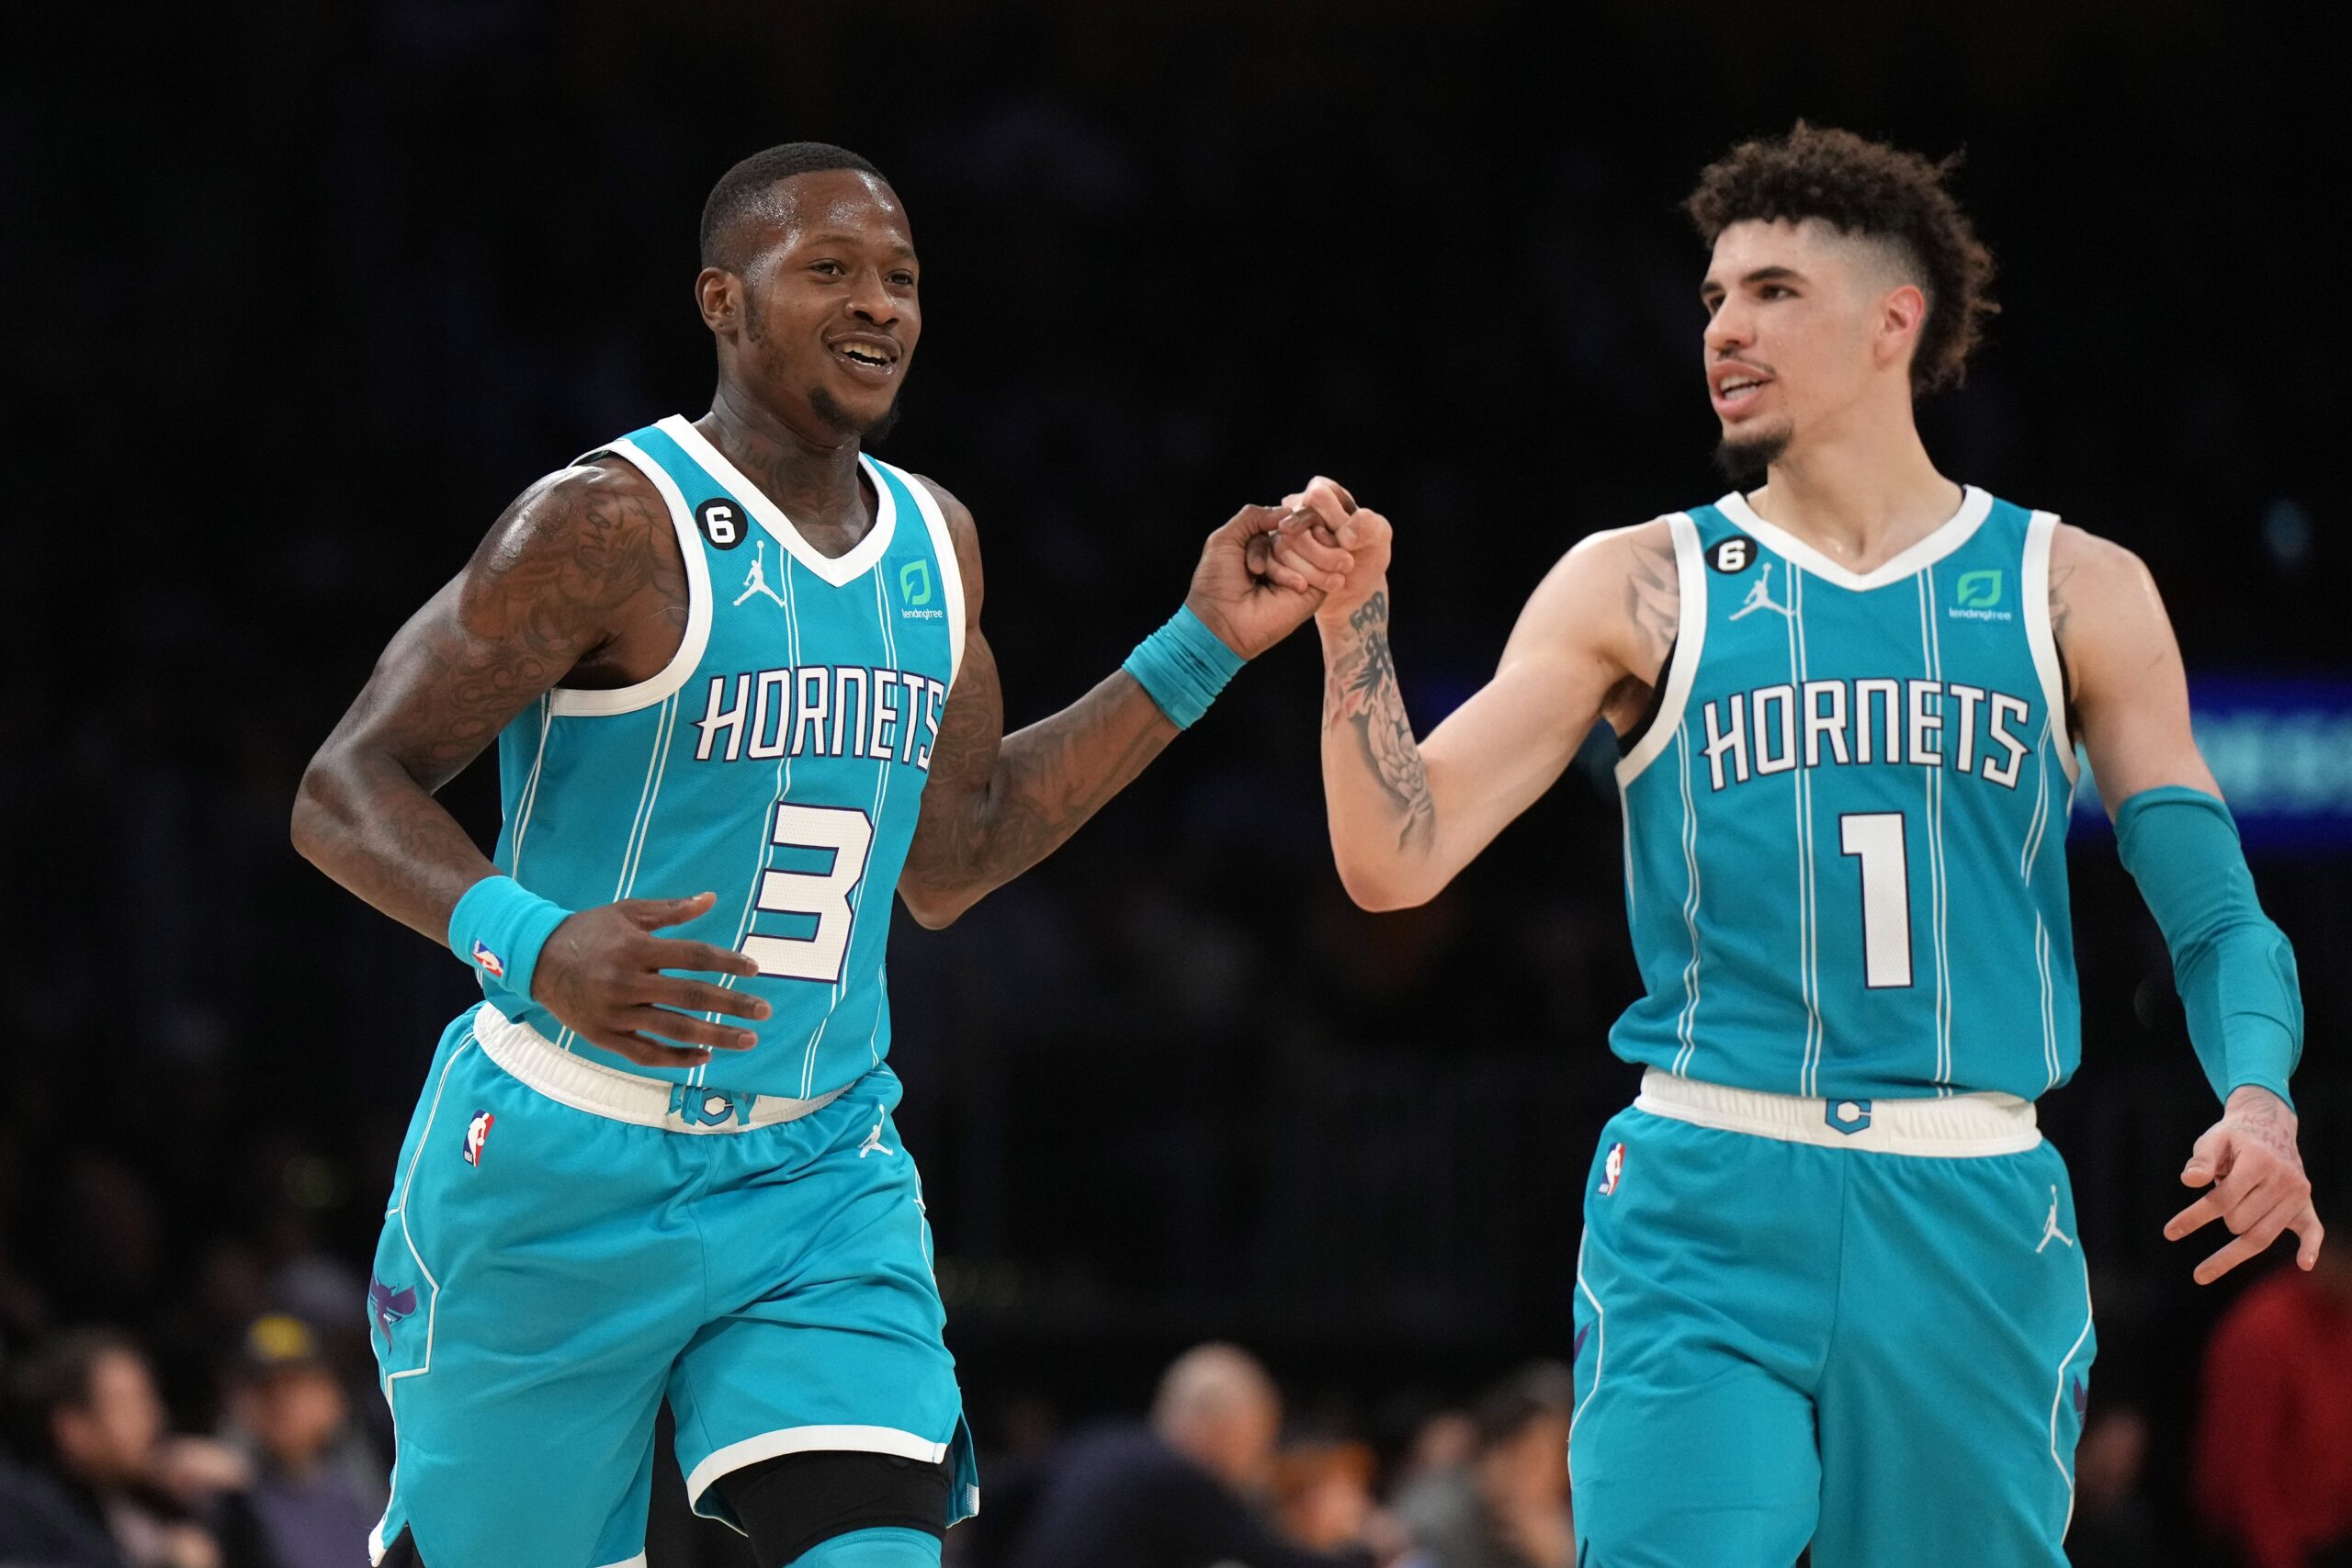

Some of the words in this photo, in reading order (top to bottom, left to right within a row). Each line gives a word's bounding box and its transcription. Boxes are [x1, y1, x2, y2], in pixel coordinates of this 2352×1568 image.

[706, 506, 736, 543] 6
[1718, 539, 1746, 571] 6
[901, 607, 943, 620] lendingtree
[690, 664, 944, 773] HORNETS
[1699, 678, 2031, 793] HORNETS
[739, 800, 875, 985] 3
[1839, 812, 1914, 989] 1
